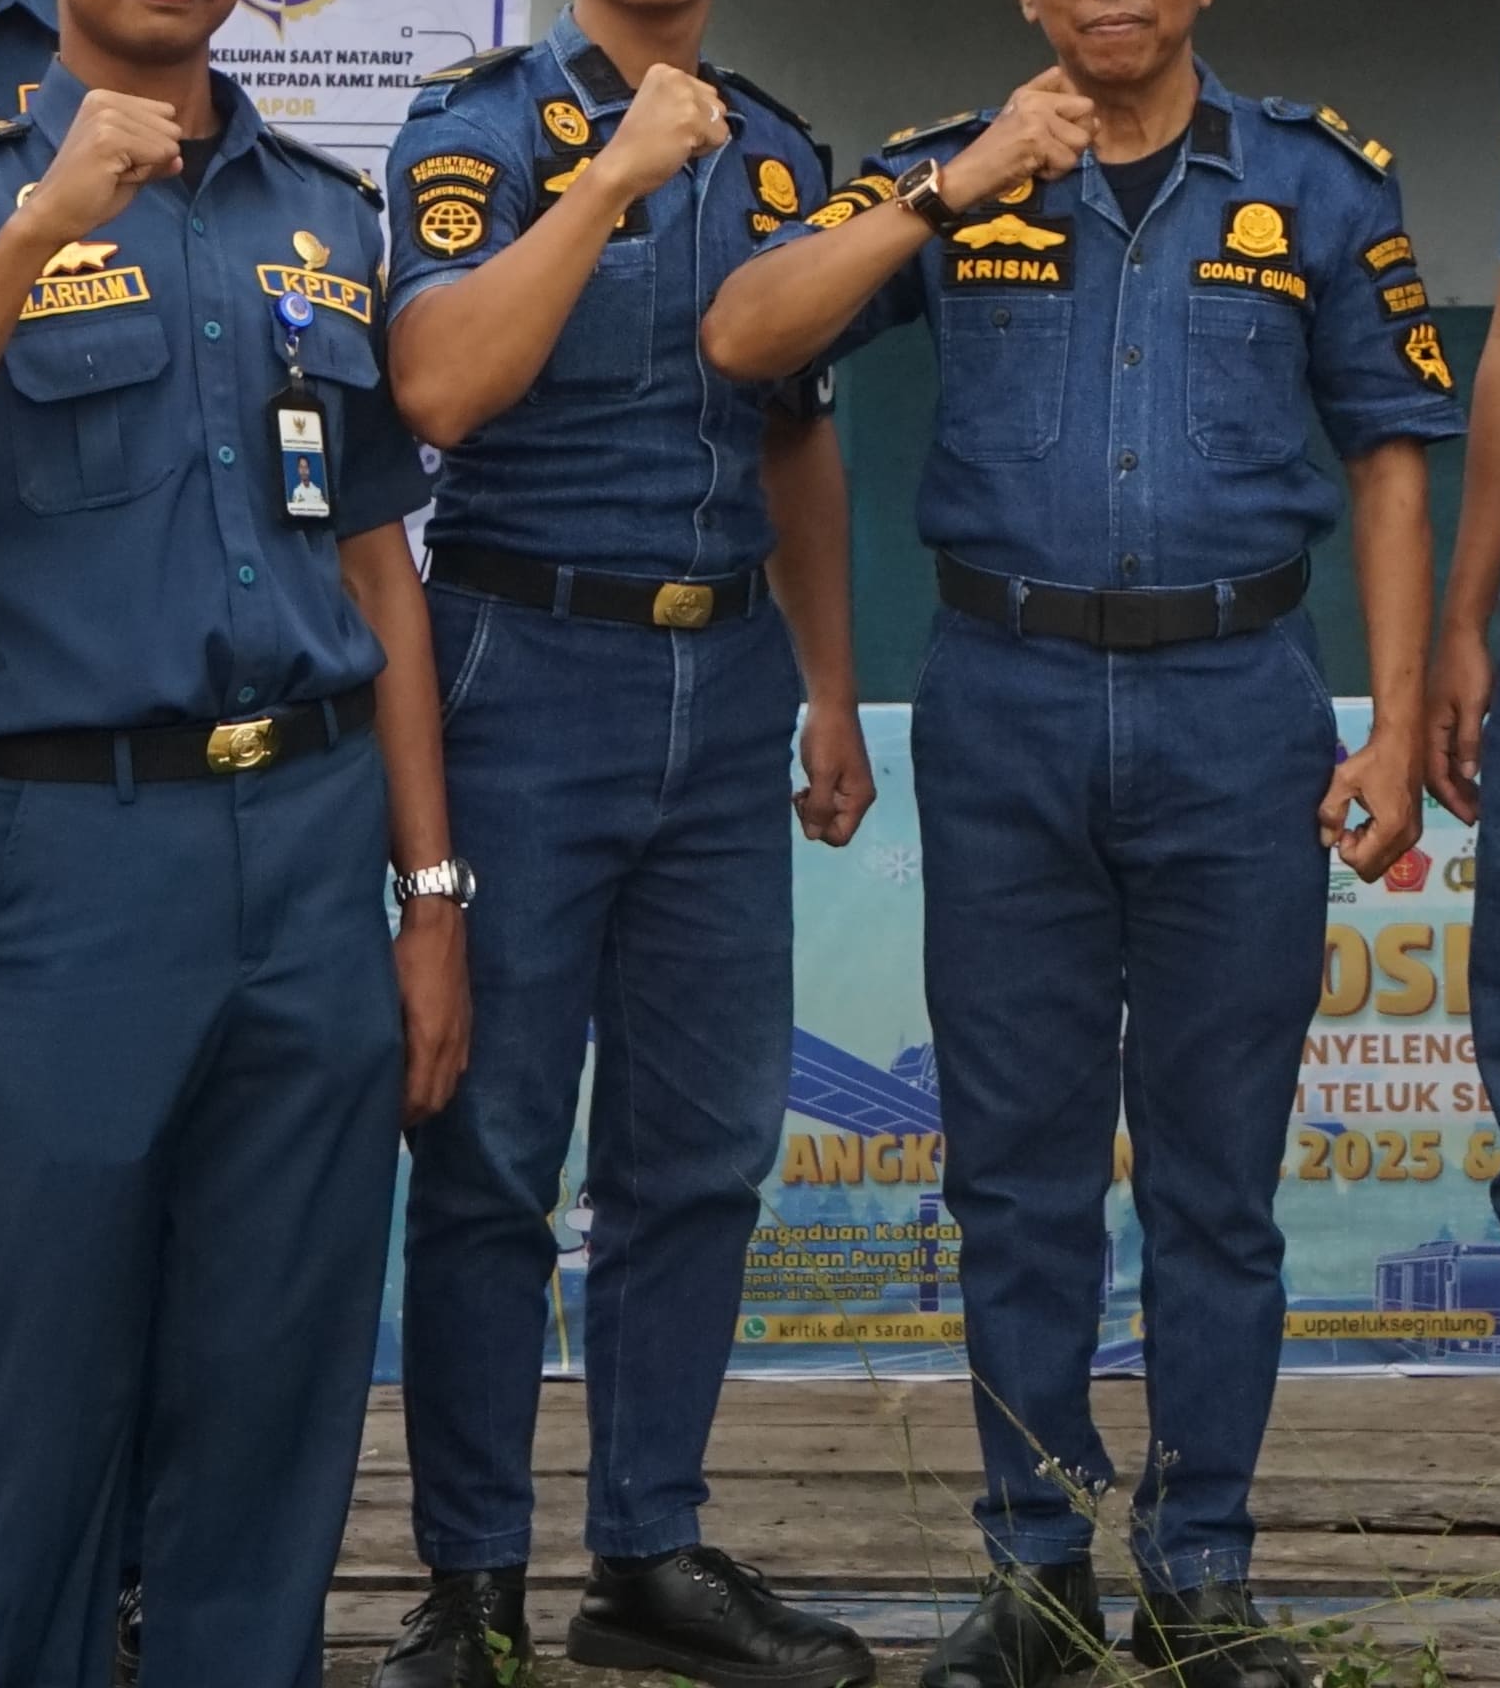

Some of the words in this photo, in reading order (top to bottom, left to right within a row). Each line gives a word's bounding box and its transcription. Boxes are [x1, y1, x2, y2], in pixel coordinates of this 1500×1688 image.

[210, 49, 286, 63] KELUHAN
[290, 50, 333, 64] SAAT
[337, 51, 414, 65] NATARU?
[257, 73, 321, 87] KEPADA
[326, 74, 374, 88] KAMI
[257, 97, 316, 115] APOR
[957, 259, 1060, 281] KRISNA
[1199, 262, 1257, 284] COAST
[1260, 269, 1306, 299] GUARD
[281, 271, 357, 306] KPLP
[1317, 1082, 1441, 1113] TELUK
[1297, 1129, 1444, 1182] 2025
[852, 1248, 927, 1273] Pungli
[778, 1321, 828, 1337] kritik
[874, 1324, 924, 1337] saran
